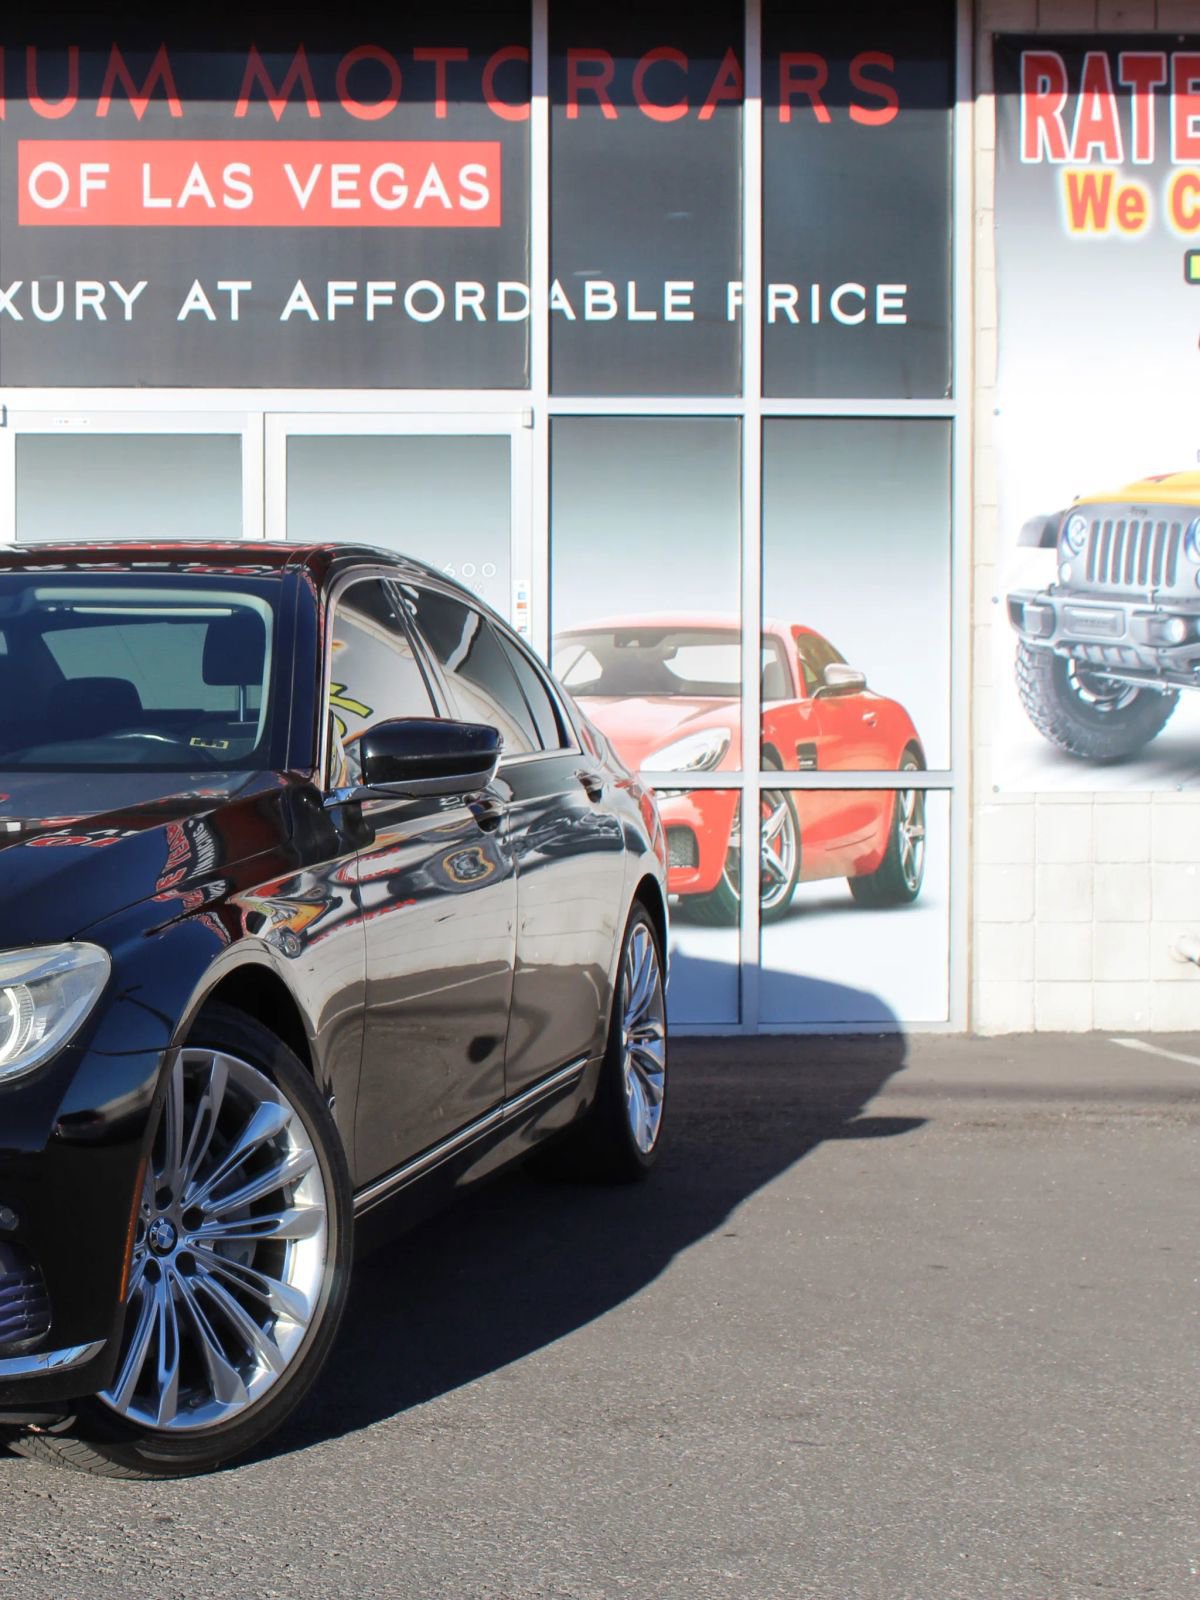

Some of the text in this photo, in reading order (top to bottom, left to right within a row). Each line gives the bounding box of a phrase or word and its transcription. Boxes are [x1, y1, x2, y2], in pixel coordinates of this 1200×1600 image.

[234, 43, 900, 126] MOTORCARS
[28, 162, 490, 211] OF LAS VEGAS
[1064, 170, 1146, 235] We
[177, 279, 252, 321] AT
[280, 279, 694, 321] AFFORDABLE
